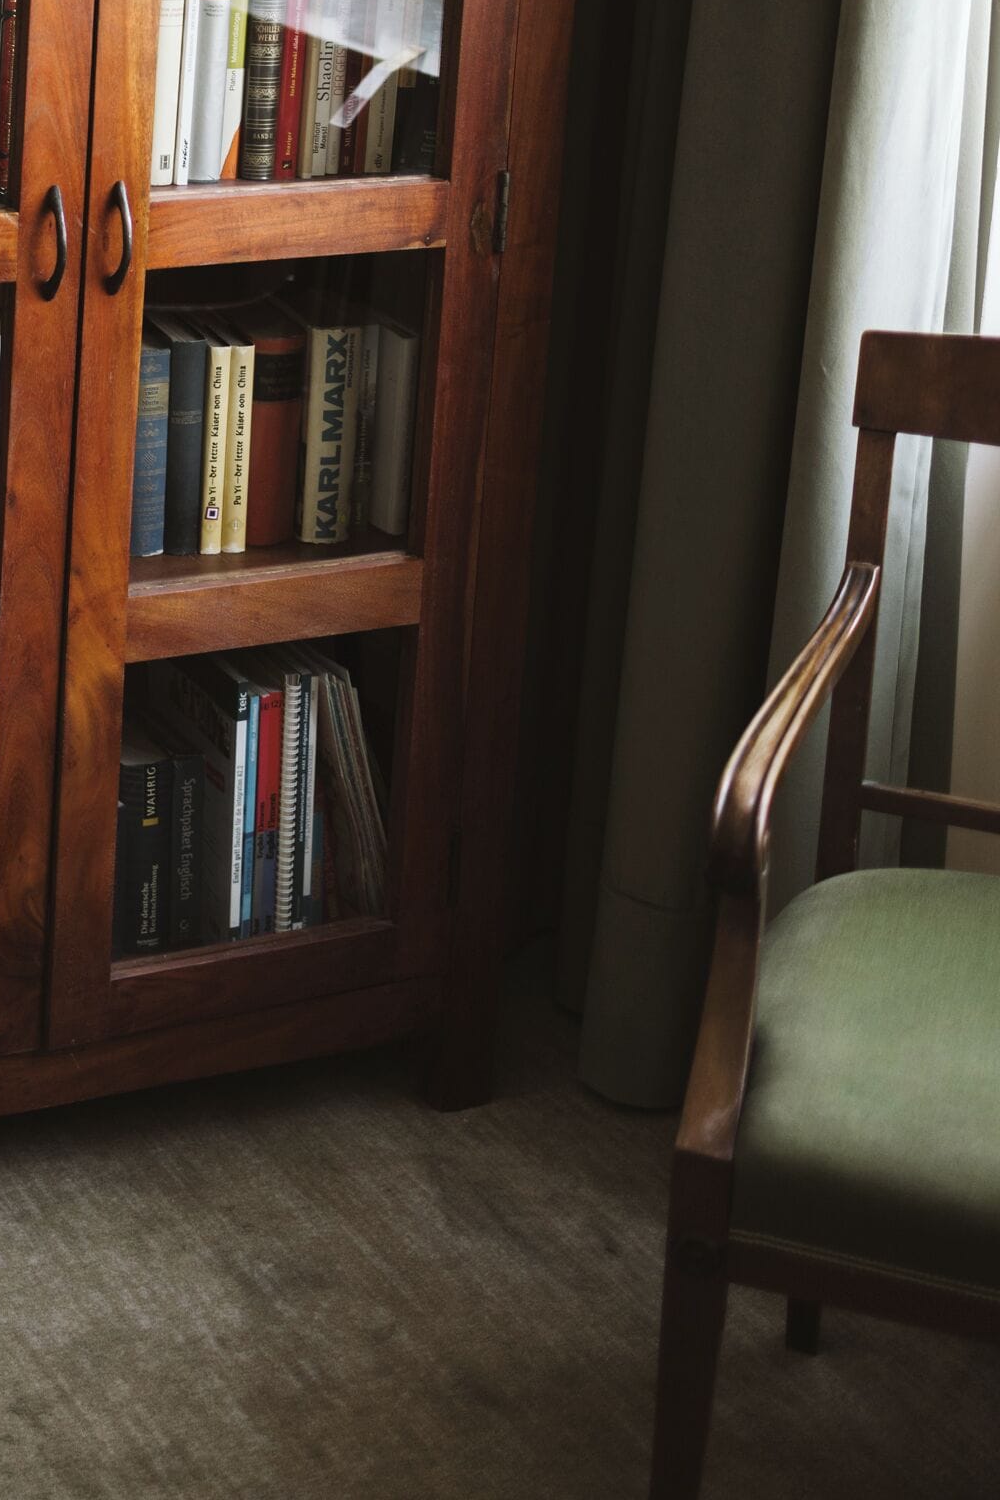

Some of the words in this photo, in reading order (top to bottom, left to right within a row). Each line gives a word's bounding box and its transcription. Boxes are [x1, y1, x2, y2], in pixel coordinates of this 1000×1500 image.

[229, 70, 237, 91] Platon
[316, 41, 334, 102] Shaolin
[333, 75, 345, 96] DER
[312, 122, 321, 154] Bernhard
[374, 154, 383, 169] dtv
[213, 366, 222, 389] China
[237, 365, 247, 388] China
[320, 334, 348, 443] MARX
[213, 394, 221, 409] von
[238, 393, 246, 408] von
[211, 412, 220, 437] Kaiser
[235, 411, 245, 436] Kaiser
[207, 496, 216, 506] Pu
[233, 495, 242, 506] Pu
[314, 445, 342, 540] KARL
[237, 692, 248, 713] telc
[146, 766, 157, 817] WAHRIG
[180, 778, 196, 850] Sprachpaket
[177, 853, 193, 900] Englisch
[232, 862, 240, 884] Einfach
[141, 881, 150, 918] deutsche
[149, 864, 159, 933] Rechtschreibung
[140, 920, 149, 934] Die
